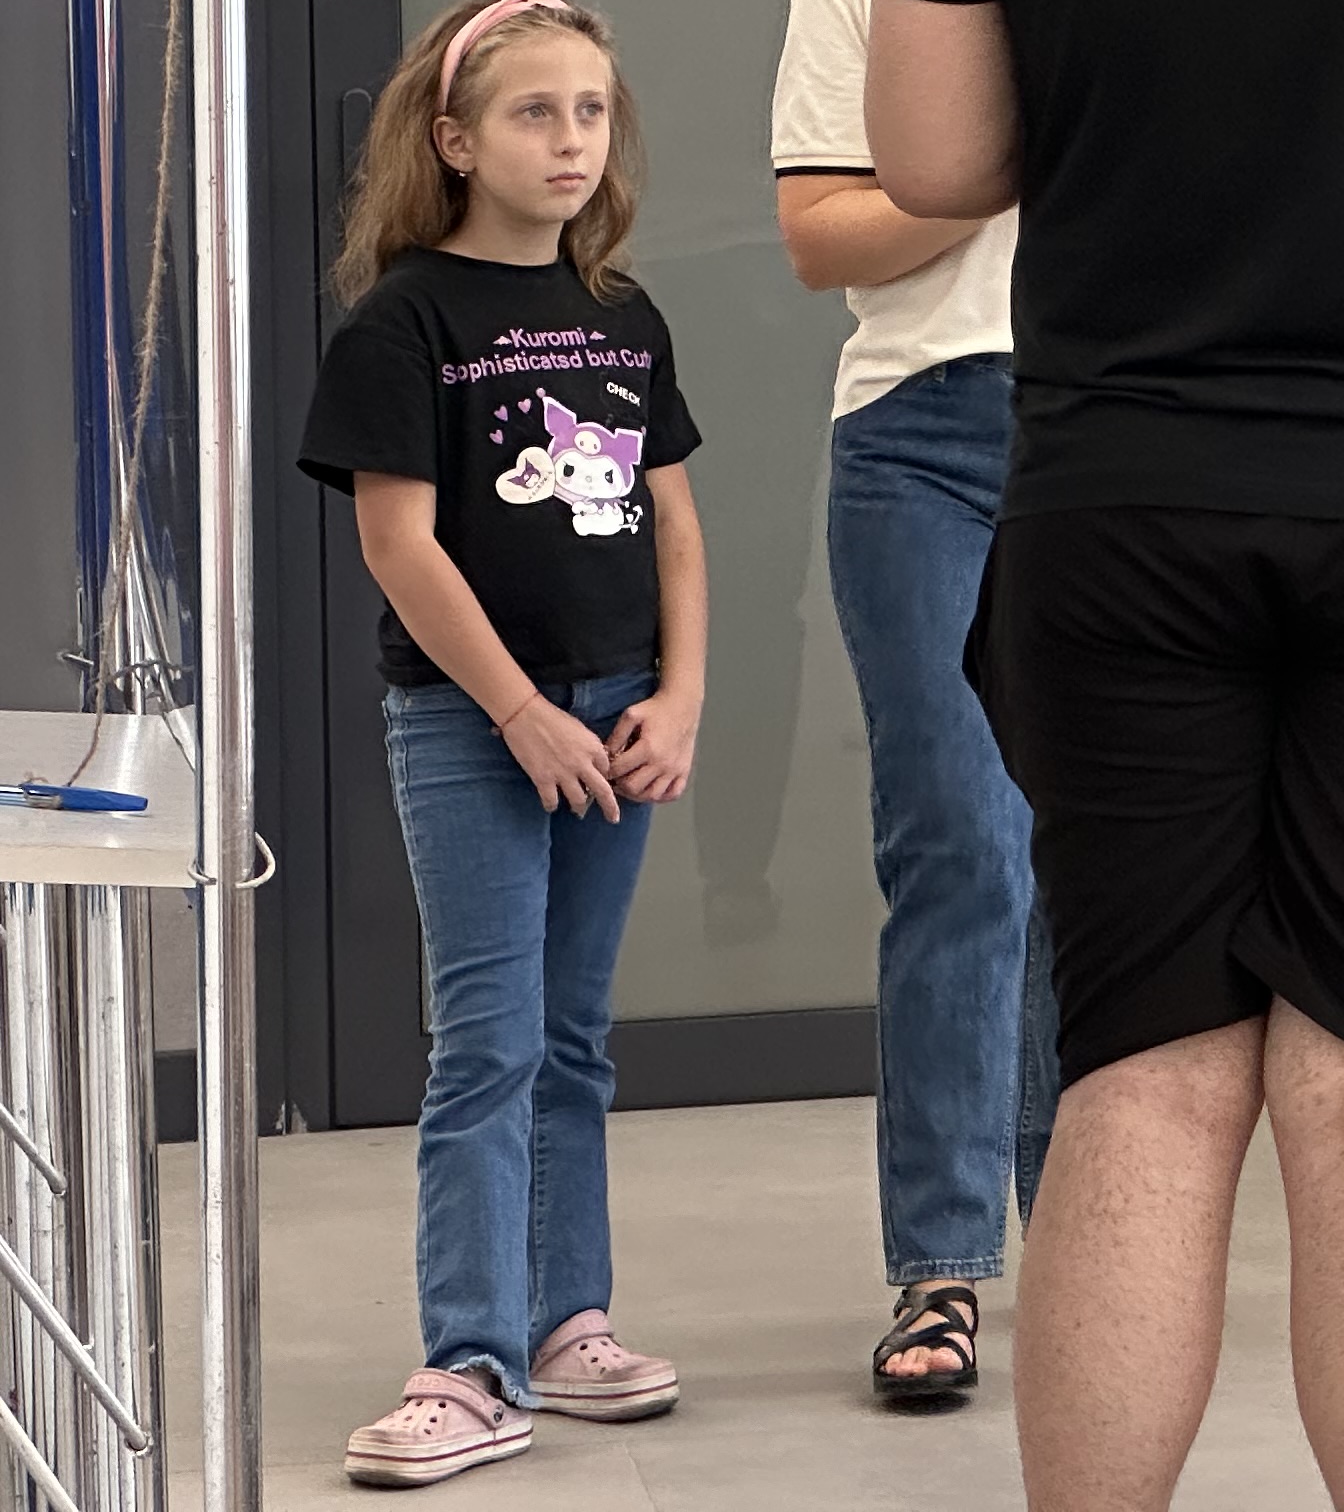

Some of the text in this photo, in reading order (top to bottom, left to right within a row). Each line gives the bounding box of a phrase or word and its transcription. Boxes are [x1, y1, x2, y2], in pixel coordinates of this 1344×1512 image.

[509, 326, 587, 349] Kuromi
[585, 348, 620, 367] but
[620, 348, 652, 370] Cut
[606, 381, 641, 407] CHECK
